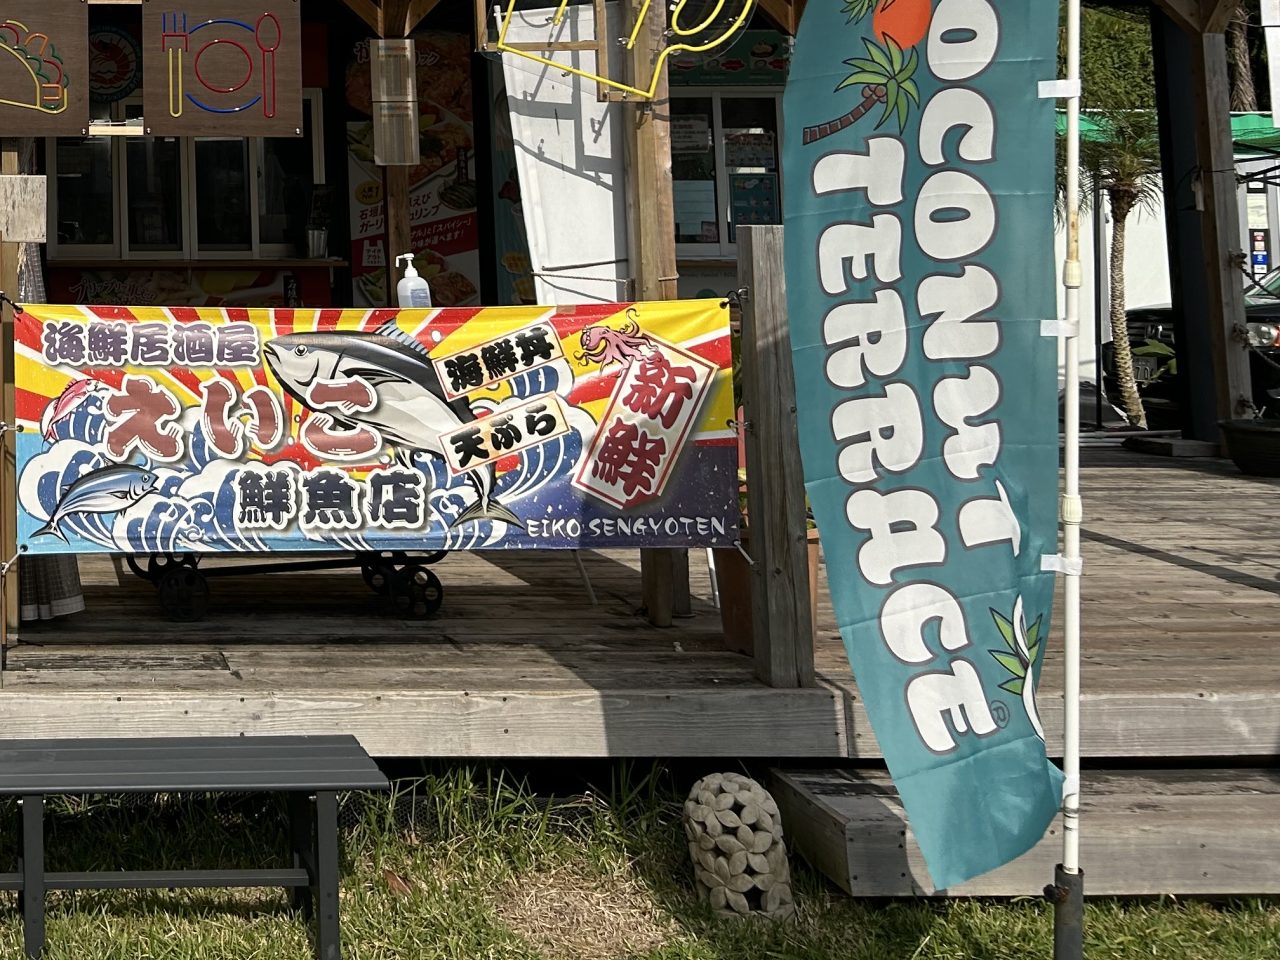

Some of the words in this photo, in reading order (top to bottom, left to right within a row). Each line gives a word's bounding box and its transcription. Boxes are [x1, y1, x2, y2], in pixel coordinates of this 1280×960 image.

[43, 321, 260, 365] 海鮮居酒屋
[445, 327, 556, 392] 海鮮丼
[106, 375, 383, 461] えいこ
[450, 402, 558, 468] 天ぷら
[592, 350, 698, 496] 新鮮
[236, 468, 427, 528] 鮮魚店
[526, 518, 582, 538] EIKO
[588, 516, 726, 538] SENGYOTEN
